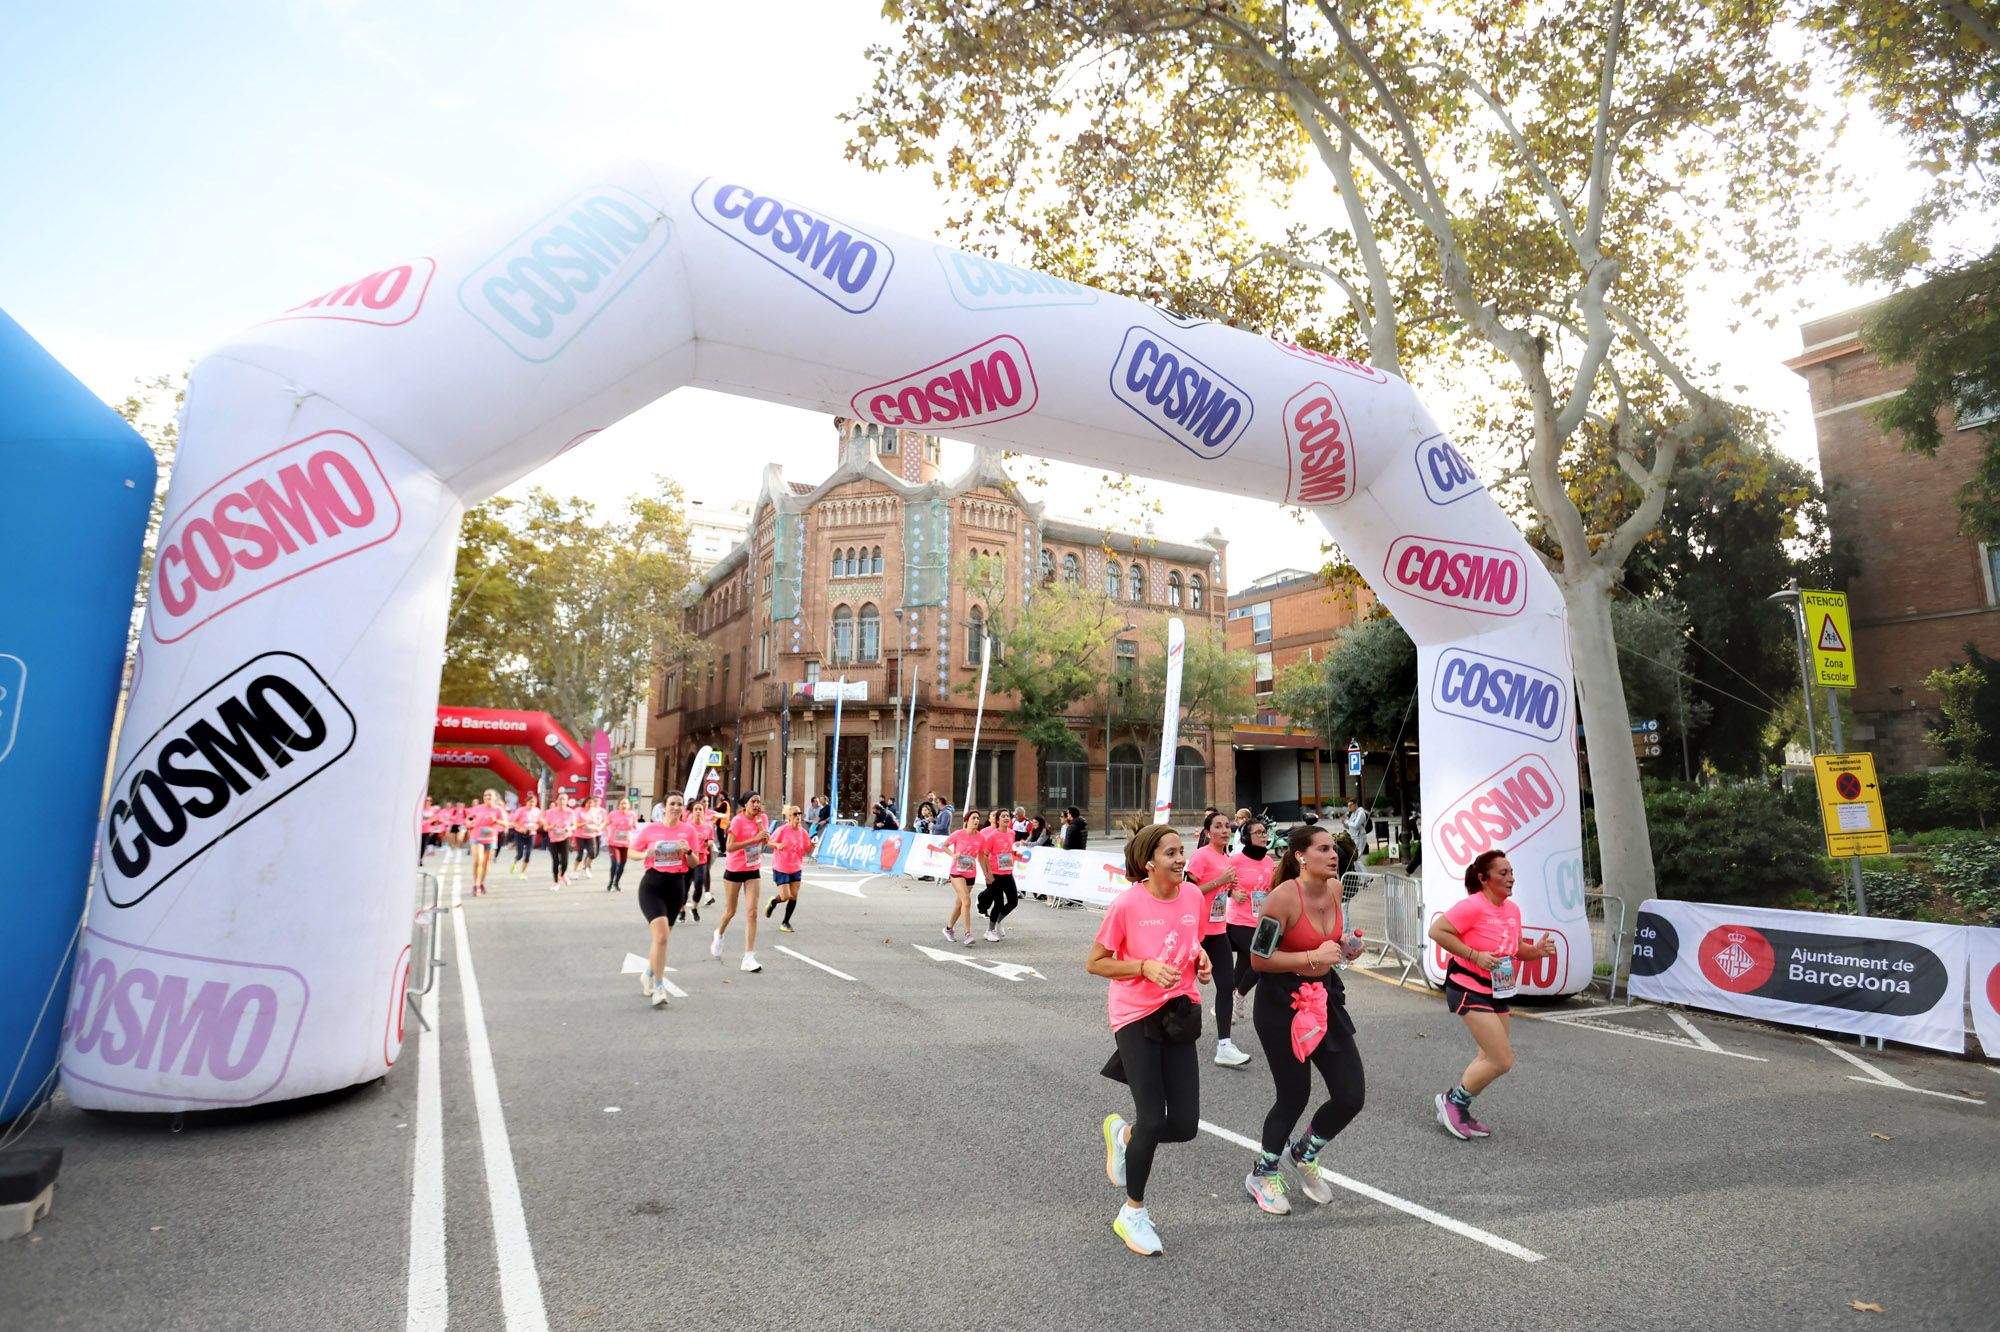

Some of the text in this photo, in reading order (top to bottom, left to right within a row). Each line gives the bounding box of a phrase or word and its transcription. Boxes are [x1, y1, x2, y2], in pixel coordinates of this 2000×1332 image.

[481, 195, 649, 338] COSMO
[714, 184, 877, 294] COSMO
[869, 350, 1022, 425] COSMO
[1126, 339, 1241, 447] COSMO
[1294, 396, 1346, 501] COSMO
[159, 450, 375, 617] COSMO
[1397, 545, 1518, 605] COSMO
[1806, 596, 1844, 607] ATENCIÓ
[1441, 658, 1559, 729] COSMO
[1821, 671, 1850, 681] Escolar
[1824, 658, 1844, 668] Zona
[441, 716, 460, 728] de
[461, 716, 528, 731] Barcelona
[109, 674, 327, 878] COSMO
[1350, 754, 1358, 770] P
[1440, 766, 1555, 865] COSMO
[1640, 926, 1657, 939] de
[1790, 948, 1914, 973] Ajuntament de
[1789, 965, 1910, 994] Barcelona
